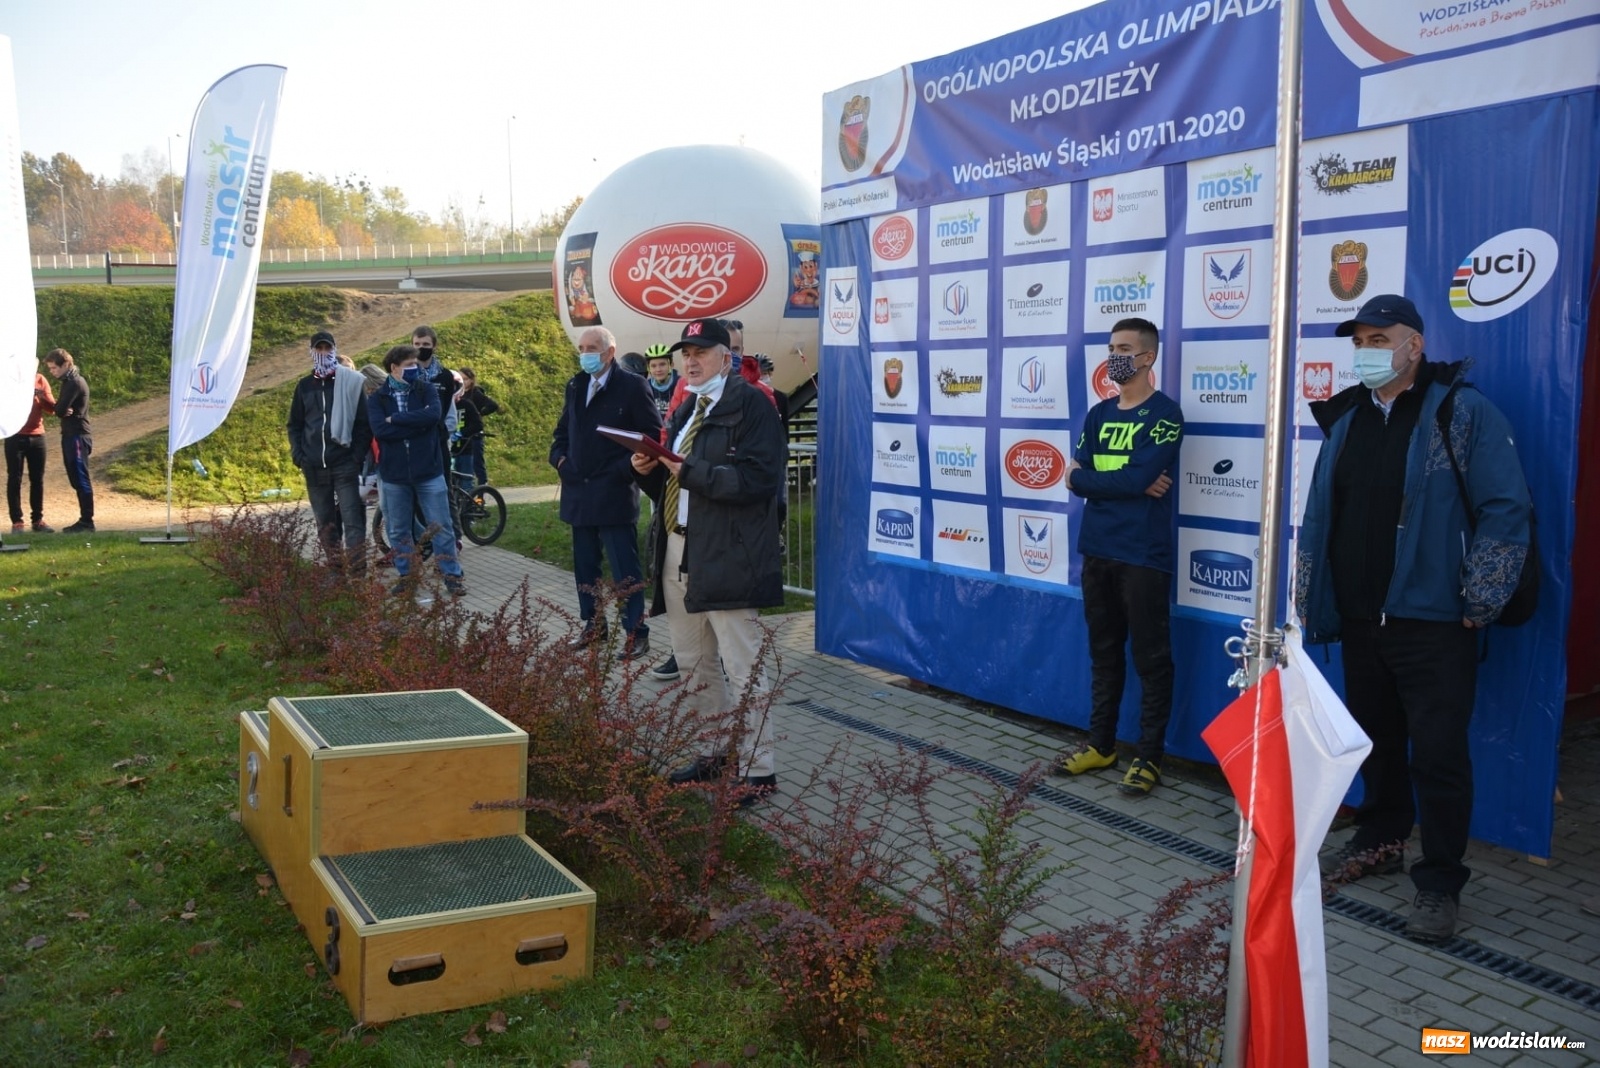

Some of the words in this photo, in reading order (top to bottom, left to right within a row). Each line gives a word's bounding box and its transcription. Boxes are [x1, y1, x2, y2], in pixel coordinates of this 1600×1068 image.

[1419, 18, 1486, 39] Południowa
[1491, 8, 1527, 24] Brama
[923, 31, 1109, 103] OGÓLNOPOLSKA
[1010, 61, 1160, 123] MŁODZIEŻY
[952, 150, 1052, 185] Wodzisław
[1057, 131, 1120, 167] Śląski
[1126, 105, 1246, 152] 07.11.2020
[1352, 157, 1397, 173] TEAM
[1197, 172, 1263, 201] mosir
[1328, 167, 1394, 187] KRAMARCZYK
[212, 125, 251, 260] mosir
[242, 155, 266, 248] centrum
[1202, 197, 1253, 213] centrum
[202, 190, 214, 246] Wodzisław
[936, 217, 981, 238] mosir
[659, 241, 736, 254] WADOWICE
[941, 235, 974, 248] centrum
[628, 245, 736, 282] skawa
[1094, 282, 1155, 303] mosir
[1208, 291, 1245, 303] AQUILA
[1007, 297, 1064, 309] Timemaster
[1101, 302, 1147, 314] centrum
[832, 311, 854, 320] AQUILA
[959, 376, 983, 384] TEAM
[1192, 372, 1257, 391] mosir
[1199, 391, 1247, 404] centrum
[1099, 422, 1145, 450] FOX
[876, 450, 916, 462] Timemaster
[935, 450, 978, 468] mosir
[940, 467, 972, 478] centrum
[1186, 472, 1260, 489] Timemaster
[1201, 488, 1213, 496] KG
[877, 516, 913, 537] KAPRIN
[1024, 549, 1049, 560] AQUILA
[1192, 561, 1250, 587] KAPRIN
[324, 906, 341, 976] 3
